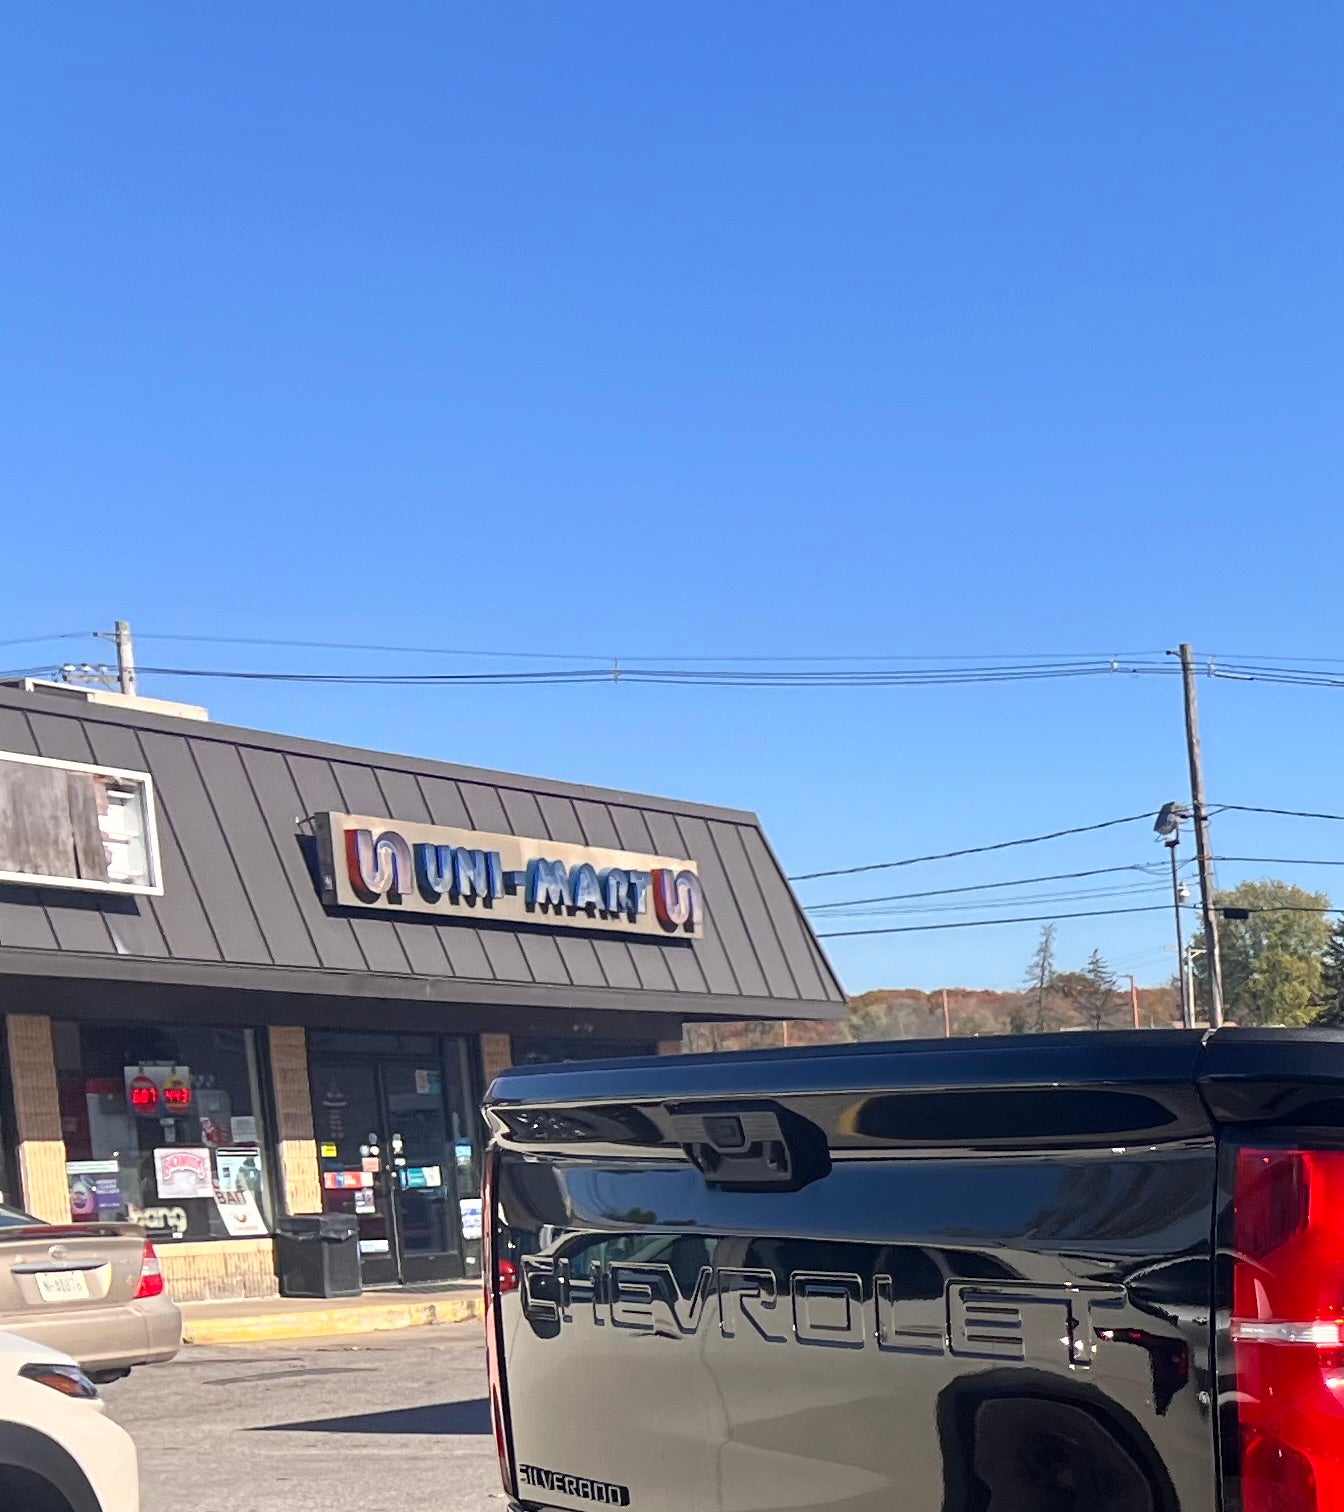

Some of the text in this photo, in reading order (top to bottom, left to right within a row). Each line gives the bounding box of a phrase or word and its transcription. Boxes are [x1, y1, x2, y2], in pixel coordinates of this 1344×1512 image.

[413, 843, 651, 919] UNI-MART
[215, 1189, 247, 1205] BAIT
[520, 1254, 1127, 1369] CHEVROLET
[518, 1464, 630, 1507] SILVERADO
